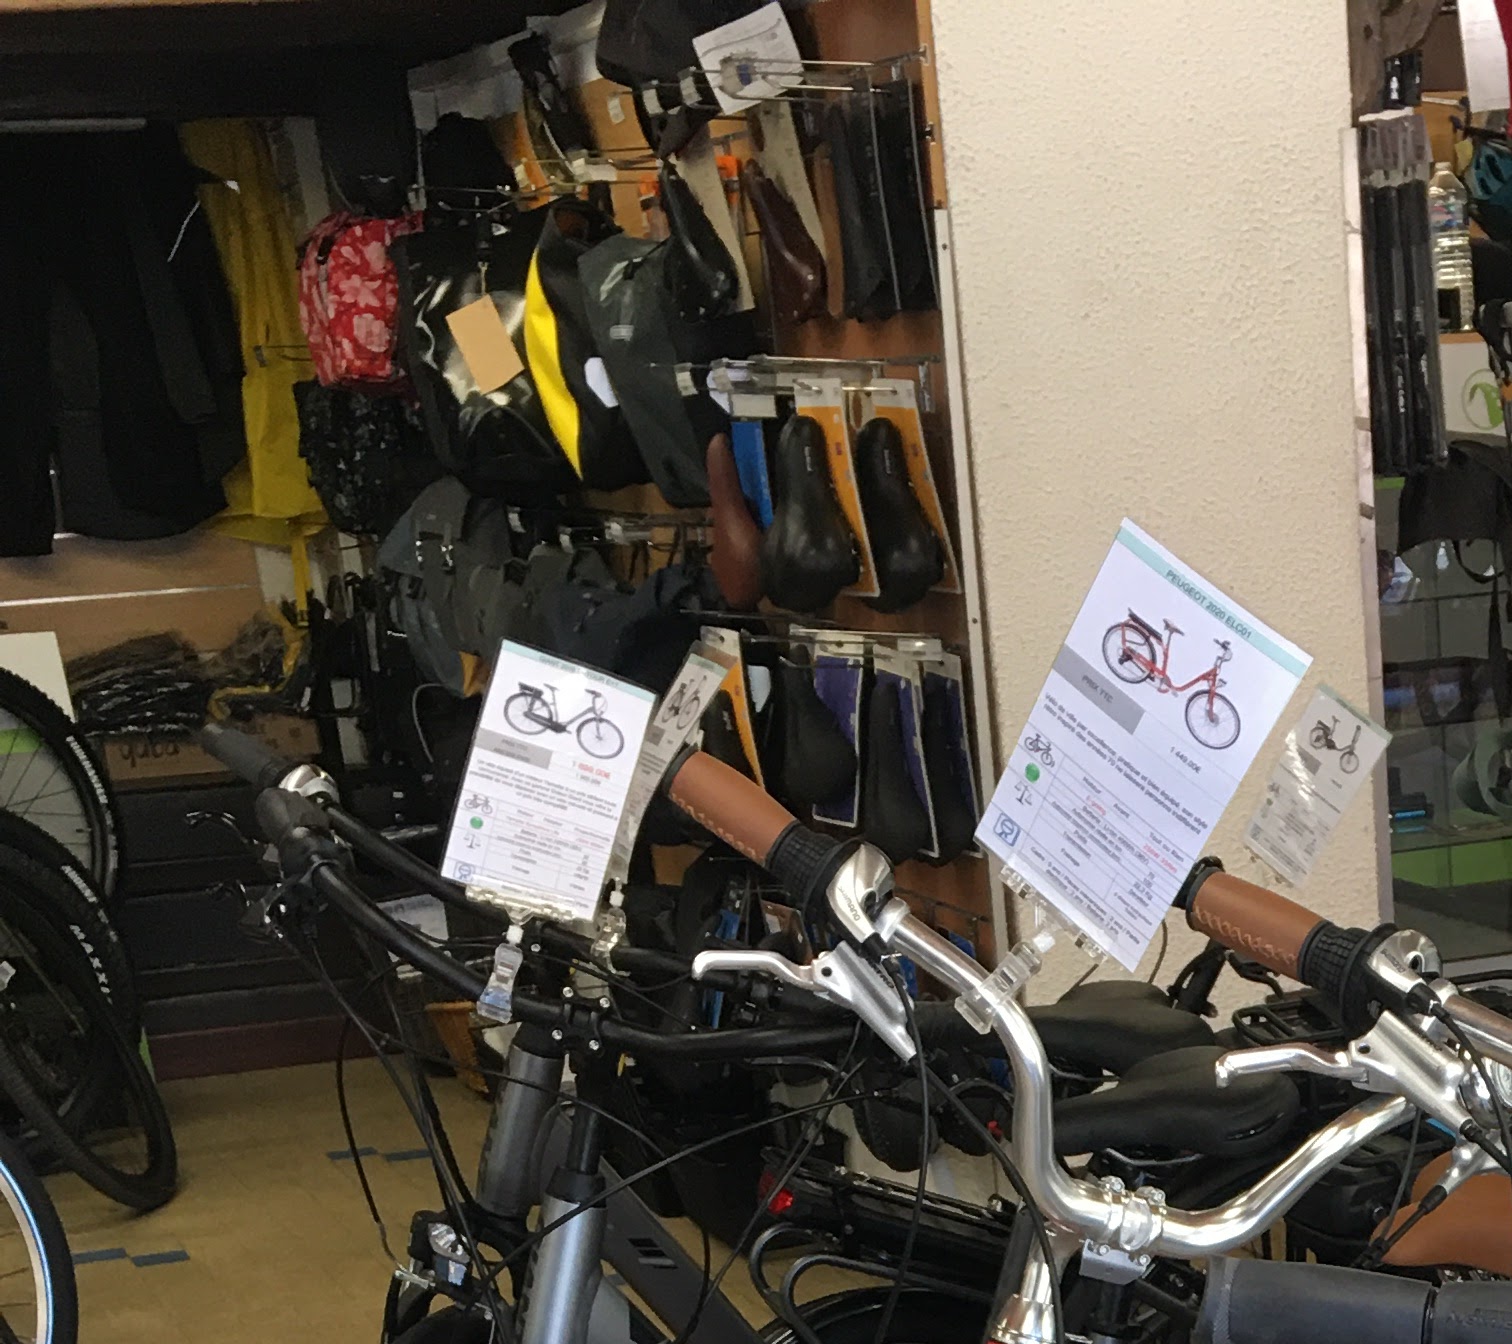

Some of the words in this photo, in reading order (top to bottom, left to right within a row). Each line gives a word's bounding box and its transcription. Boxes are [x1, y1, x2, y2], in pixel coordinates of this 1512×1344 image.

[1165, 568, 1207, 605] PEUGEOT
[1205, 599, 1226, 620] 2020
[1225, 615, 1252, 639] ELC01
[1081, 673, 1100, 692] PRIX
